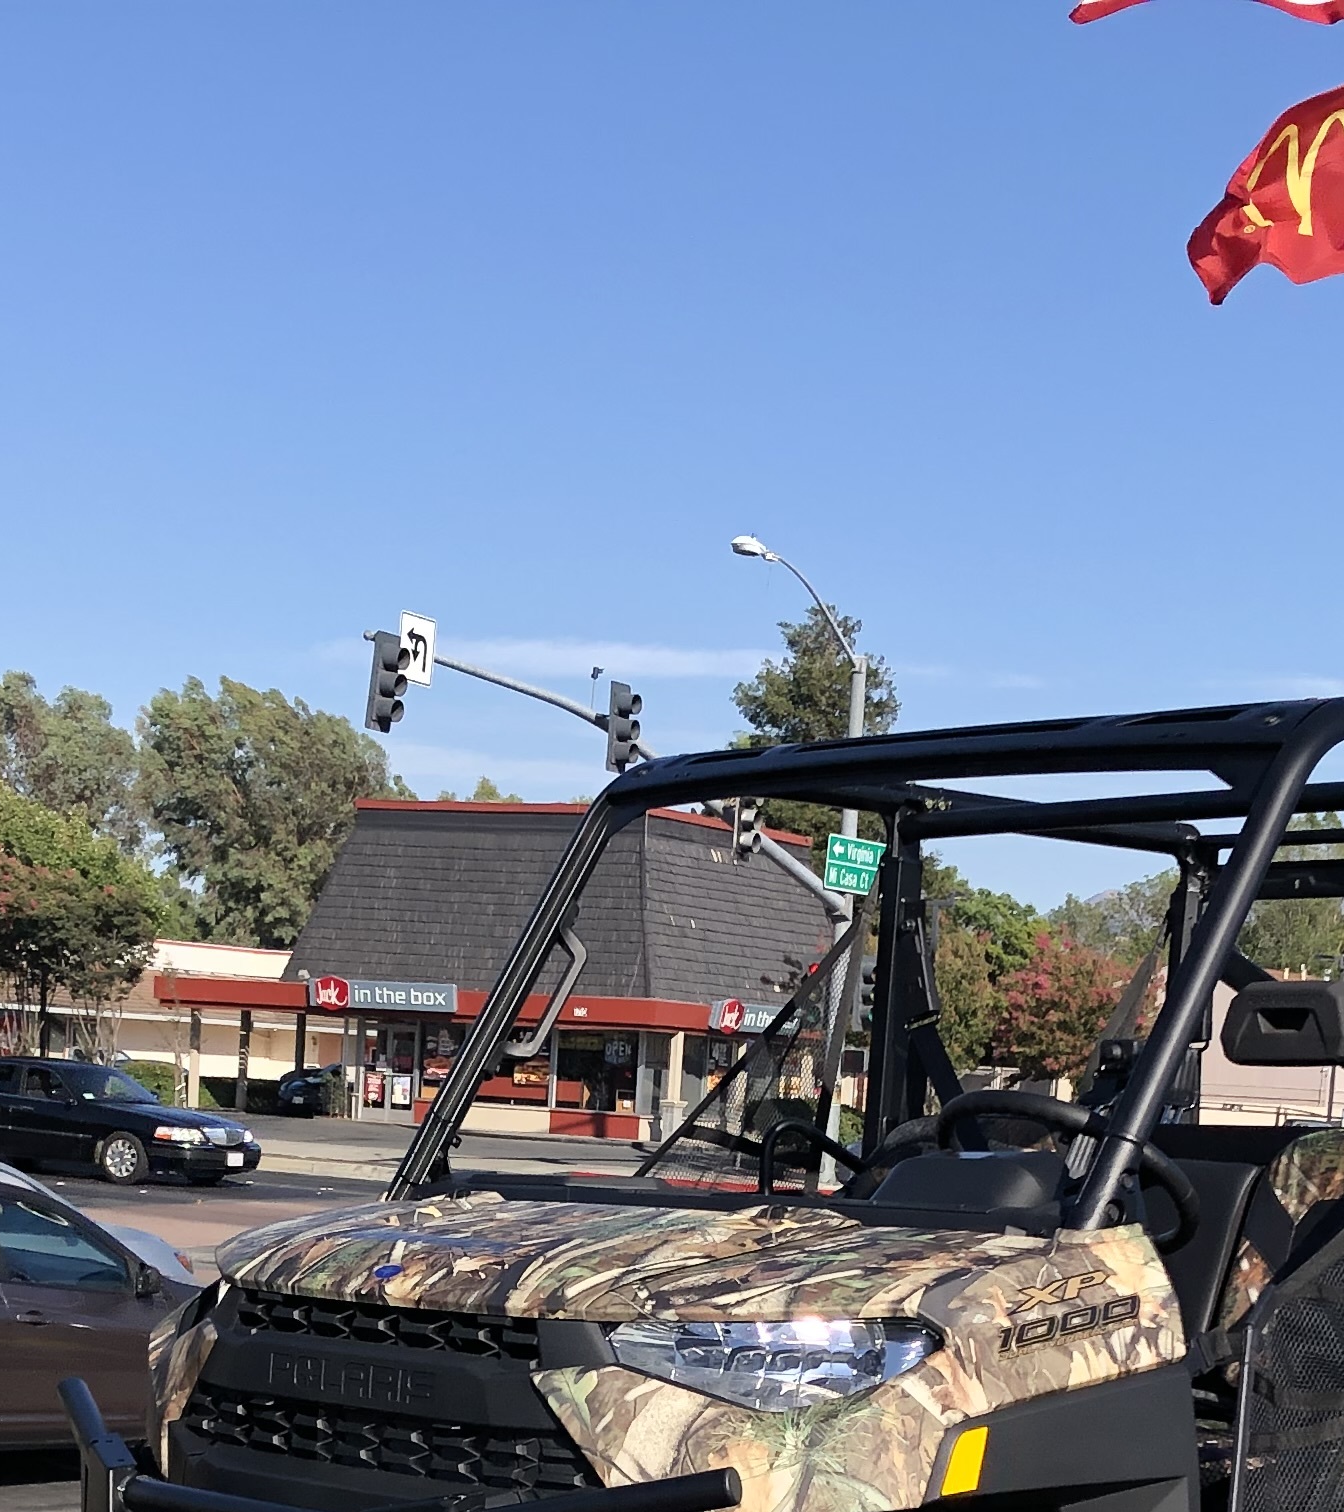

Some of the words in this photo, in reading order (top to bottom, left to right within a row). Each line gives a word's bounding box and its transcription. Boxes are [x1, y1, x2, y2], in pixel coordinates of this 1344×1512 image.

[847, 843, 874, 865] Virginia
[840, 869, 857, 887] Casa
[860, 872, 869, 889] Ct
[317, 981, 347, 1006] Jack
[355, 985, 371, 1002] in
[375, 986, 406, 1004] the
[410, 988, 446, 1006] box
[743, 1008, 756, 1027] in
[606, 1041, 631, 1056] OPEN
[1007, 1269, 1110, 1316] XP
[998, 1294, 1141, 1354] 1000
[269, 1352, 435, 1404] POLARIS
